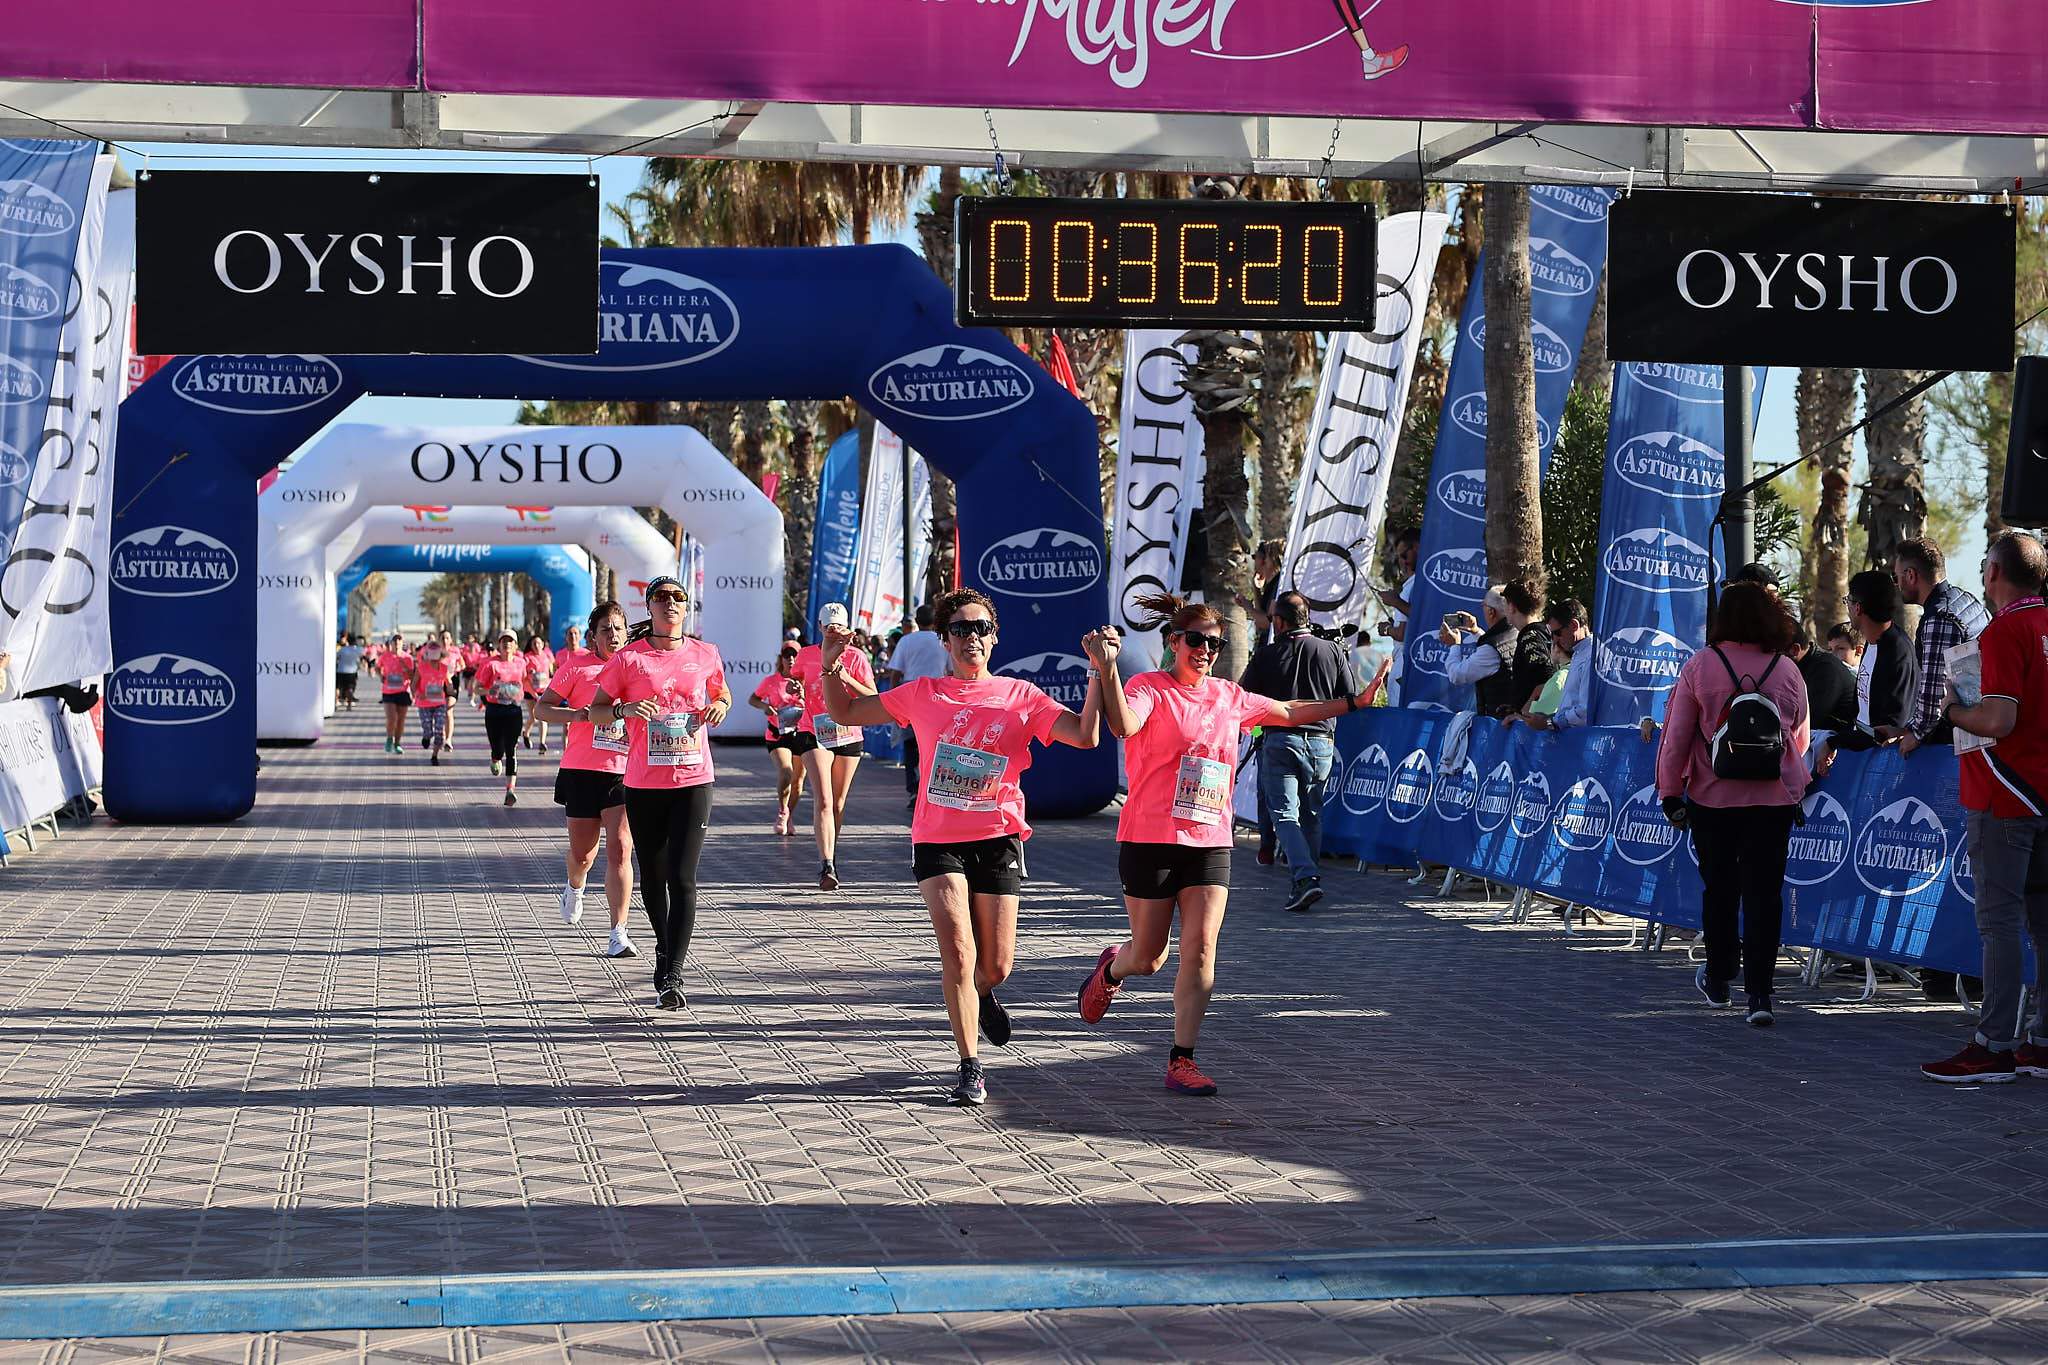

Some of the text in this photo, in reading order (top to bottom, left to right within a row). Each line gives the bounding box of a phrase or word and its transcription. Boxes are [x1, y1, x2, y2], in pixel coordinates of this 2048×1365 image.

[0, 203, 64, 229] URIANA
[214, 230, 534, 298] OYSHO
[989, 220, 1343, 305] 00:36:20
[1531, 261, 1584, 290] URIANA
[1677, 249, 1958, 315] OYSHO
[627, 294, 710, 306] LECHERA
[601, 313, 720, 343] RIANA
[182, 365, 329, 395] ASTURIANA
[211, 361, 326, 373] CENTRAL LECHERA
[904, 369, 1015, 381] CENTRAL LECHERA
[1633, 362, 1724, 391] ASTURIA
[883, 376, 1024, 402] ASTURIANA
[1292, 273, 1413, 612] OYSHO
[411, 442, 622, 484] OYSHO
[1622, 448, 1725, 489] ASTURIANA
[282, 489, 346, 503] OYSHO
[683, 488, 745, 502] OYSHO
[1121, 347, 1189, 632] OYSHO
[824, 490, 859, 583] Marlene
[113, 553, 230, 580] ASTURIANA
[129, 549, 227, 560] CENTRAL LECHERA
[1005, 549, 1093, 561] CENTRAL LECHERA
[1611, 547, 1709, 583] ASTURIANA
[716, 576, 773, 589] OYSHO
[986, 556, 1097, 582] ASTURIANA
[1431, 560, 1488, 589] ASTURI
[112, 680, 226, 708] ASTURIANA
[126, 677, 223, 687] CENTRAL LECHERA
[667, 736, 688, 745] 016
[954, 774, 980, 789] 016
[1199, 786, 1216, 800] 016
[1389, 772, 1427, 806] ASTURIANA
[1617, 810, 1674, 846] ASTURIANA
[1818, 824, 1845, 835] LECHERA
[1879, 829, 1940, 843] CENTRAL LECHERA
[1787, 836, 1843, 863] STURIANA
[1858, 830, 1937, 873] ASTURIANA
